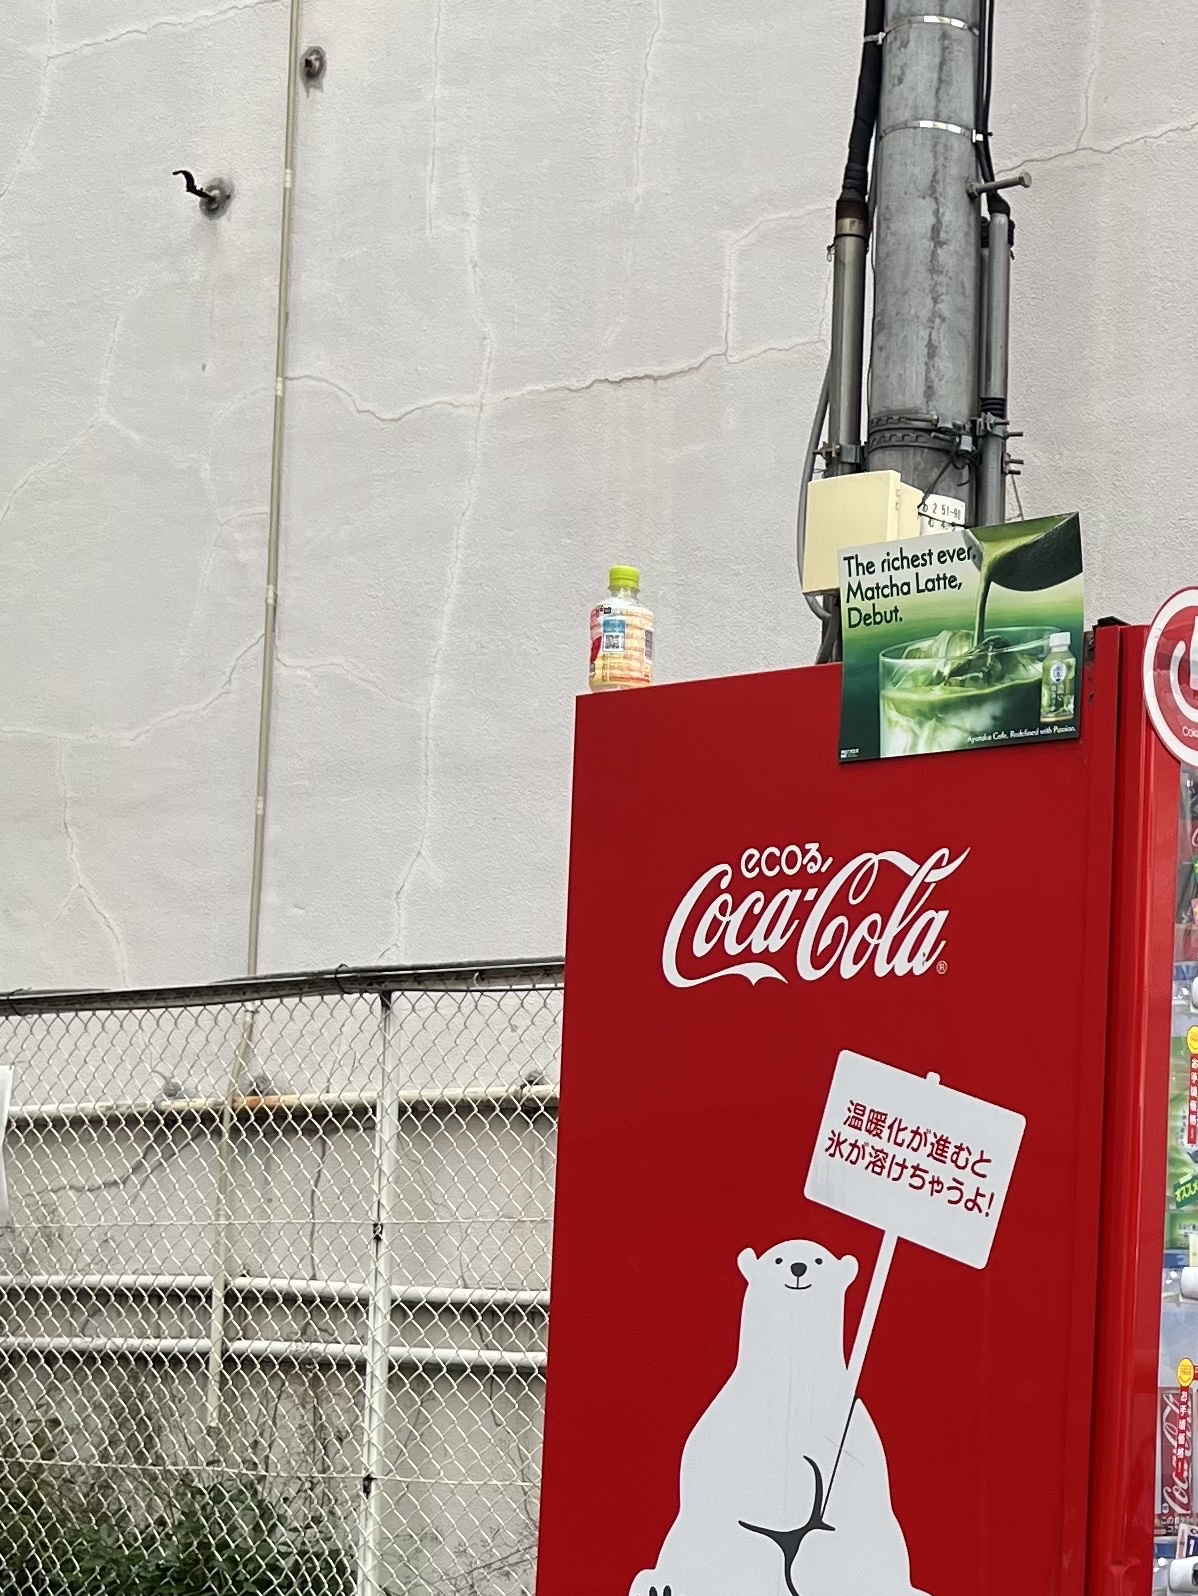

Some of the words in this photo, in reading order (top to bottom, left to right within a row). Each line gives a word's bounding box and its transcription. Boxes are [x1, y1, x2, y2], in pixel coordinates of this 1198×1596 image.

[843, 554, 876, 578] The
[881, 547, 933, 573] richest
[937, 545, 976, 566] ever.
[846, 574, 911, 603] Matcha
[915, 571, 962, 594] Latte,
[847, 602, 903, 629] Debut.
[662, 846, 971, 988] Coca-Cola
[842, 1099, 992, 1179] 温暖化が進むと
[824, 1129, 995, 1218] 氷が溶けちゃうよ!
